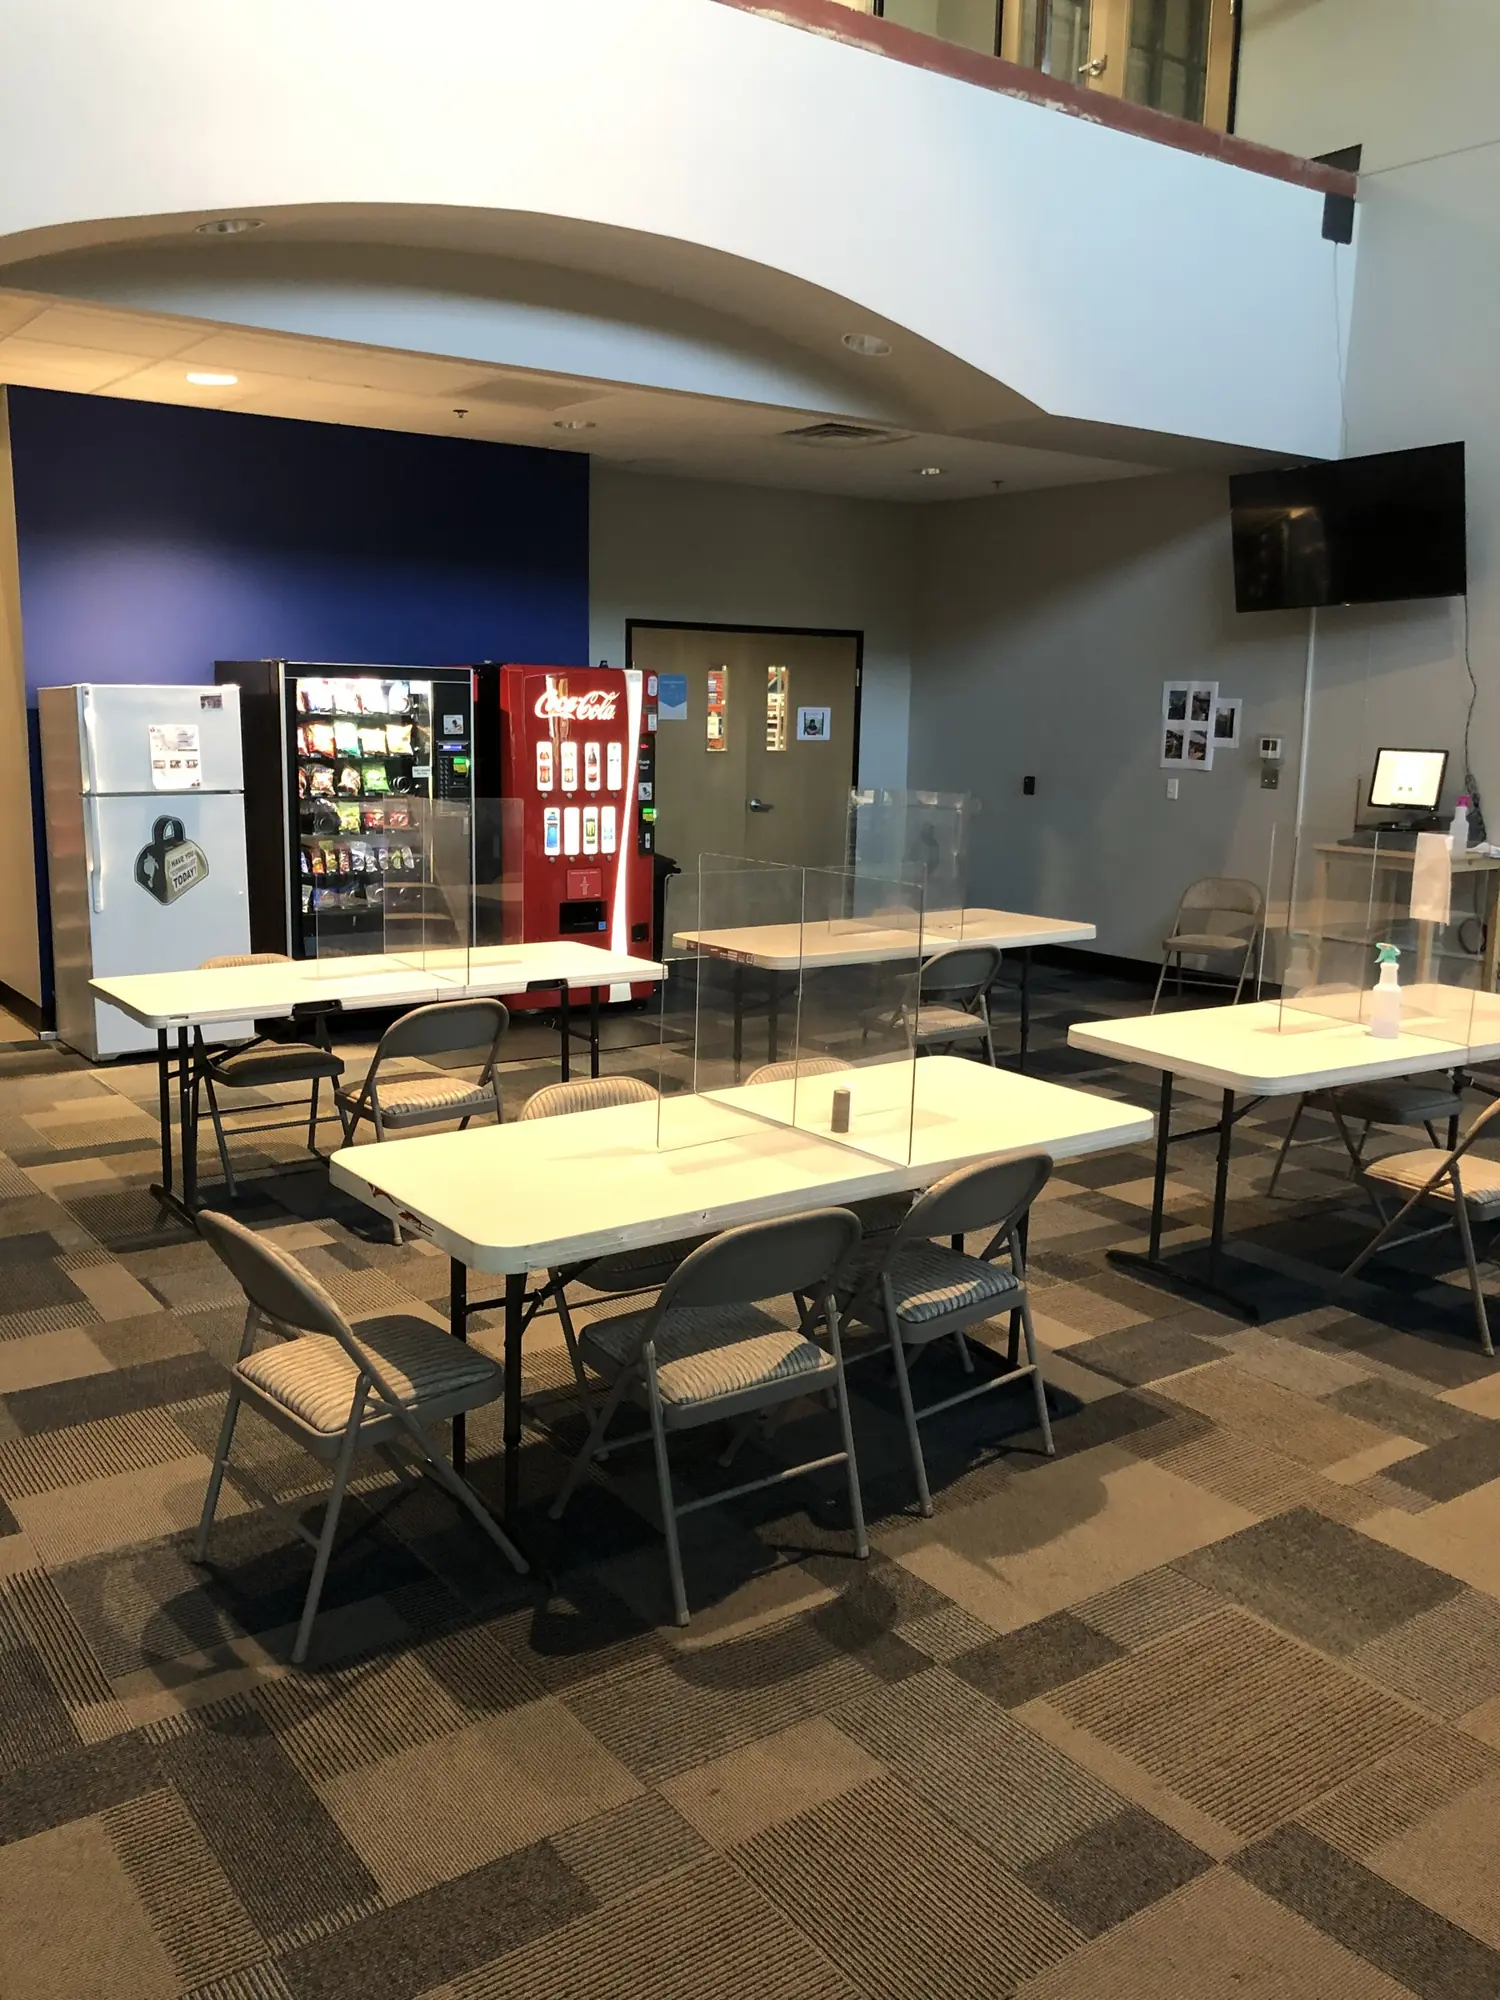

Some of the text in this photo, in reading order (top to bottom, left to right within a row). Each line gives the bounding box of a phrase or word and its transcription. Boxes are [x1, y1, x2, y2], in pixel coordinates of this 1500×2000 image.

[534, 690, 620, 720] Coca-Cola
[170, 855, 184, 868] HAVE
[185, 850, 194, 861] YOU
